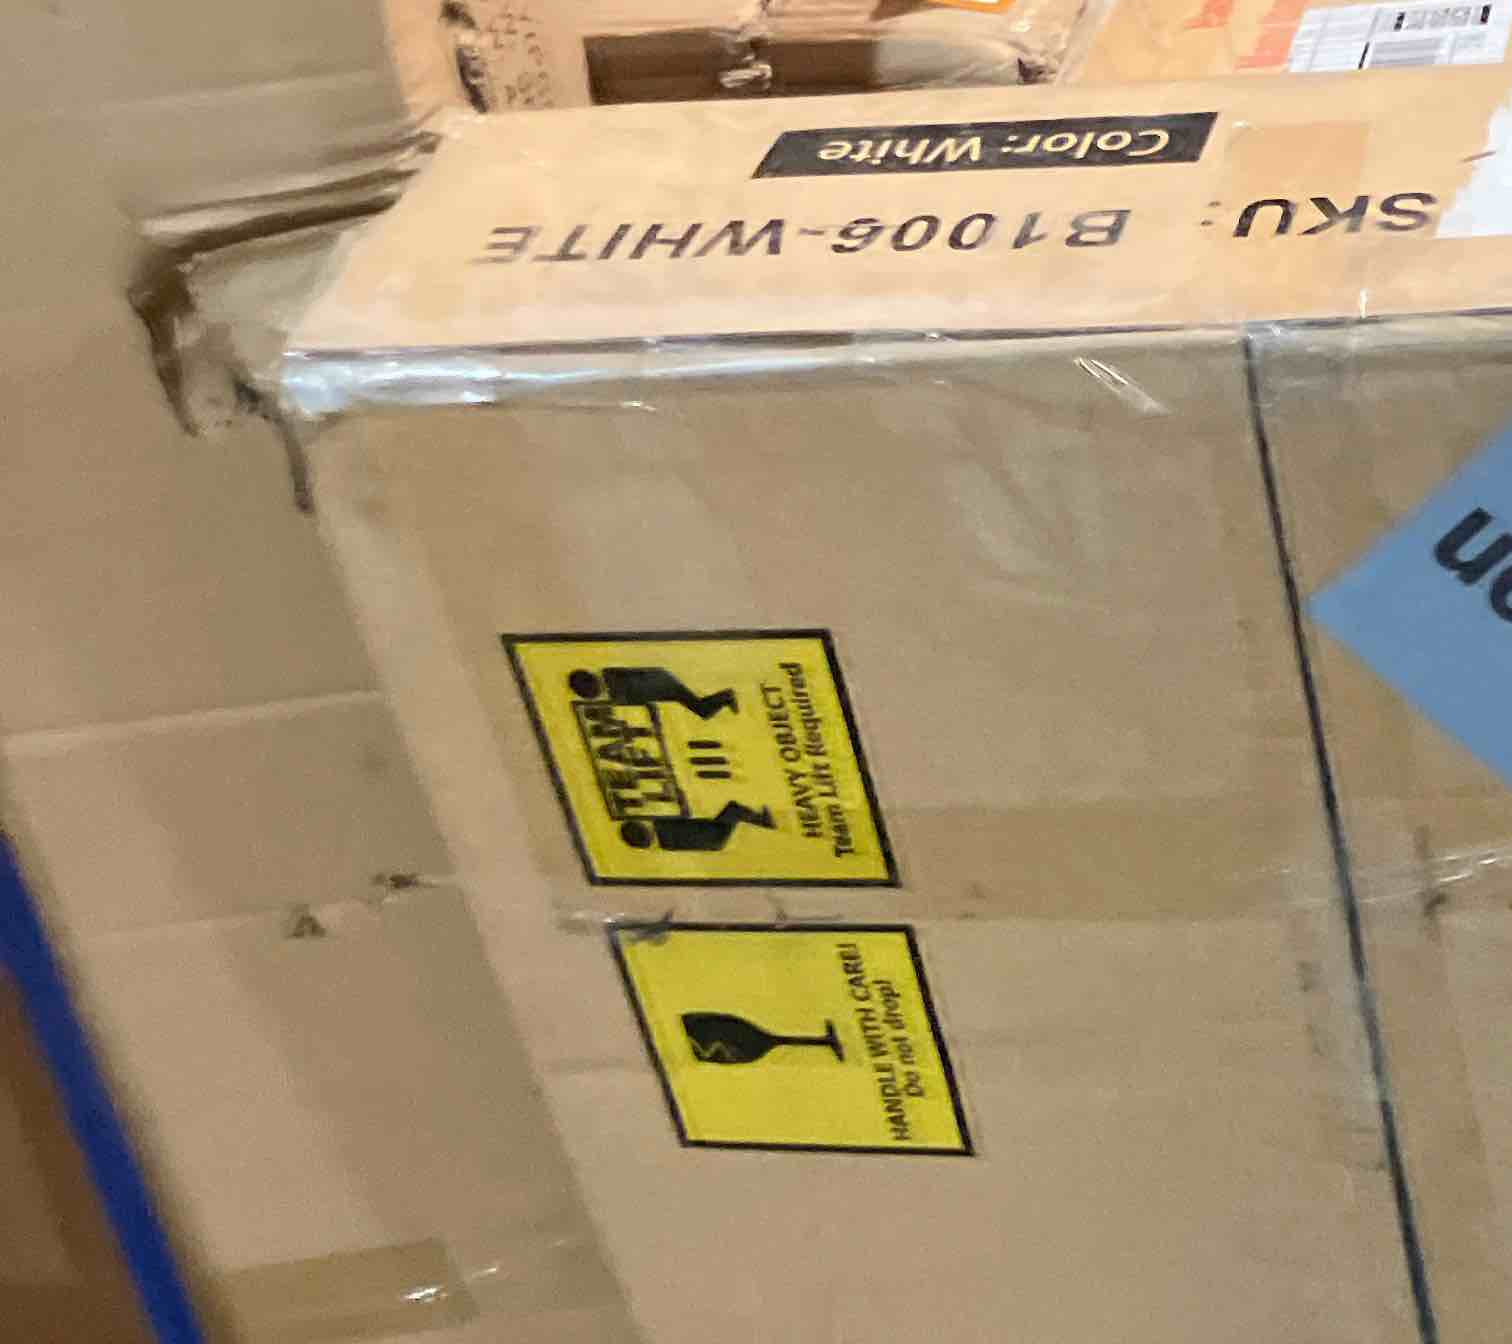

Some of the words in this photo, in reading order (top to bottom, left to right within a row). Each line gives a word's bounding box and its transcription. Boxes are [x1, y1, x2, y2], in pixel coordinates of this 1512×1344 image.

[816, 131, 983, 167] White
[1001, 127, 1170, 160] Color:
[484, 208, 1133, 264] B1006-WHITE
[760, 682, 801, 764] OBJECT
[779, 661, 826, 757] Required
[581, 706, 644, 814] TEAM
[624, 724, 677, 803] LIFT
[812, 760, 841, 799] Lift
[784, 768, 823, 838] HEAVY
[828, 804, 856, 858] Team
[836, 942, 873, 1002] CARE!
[854, 1007, 888, 1059] WITH
[872, 979, 904, 1032] drop!
[890, 1034, 917, 1067] not
[872, 1061, 913, 1141] HANDLE
[901, 1070, 926, 1099] Do
